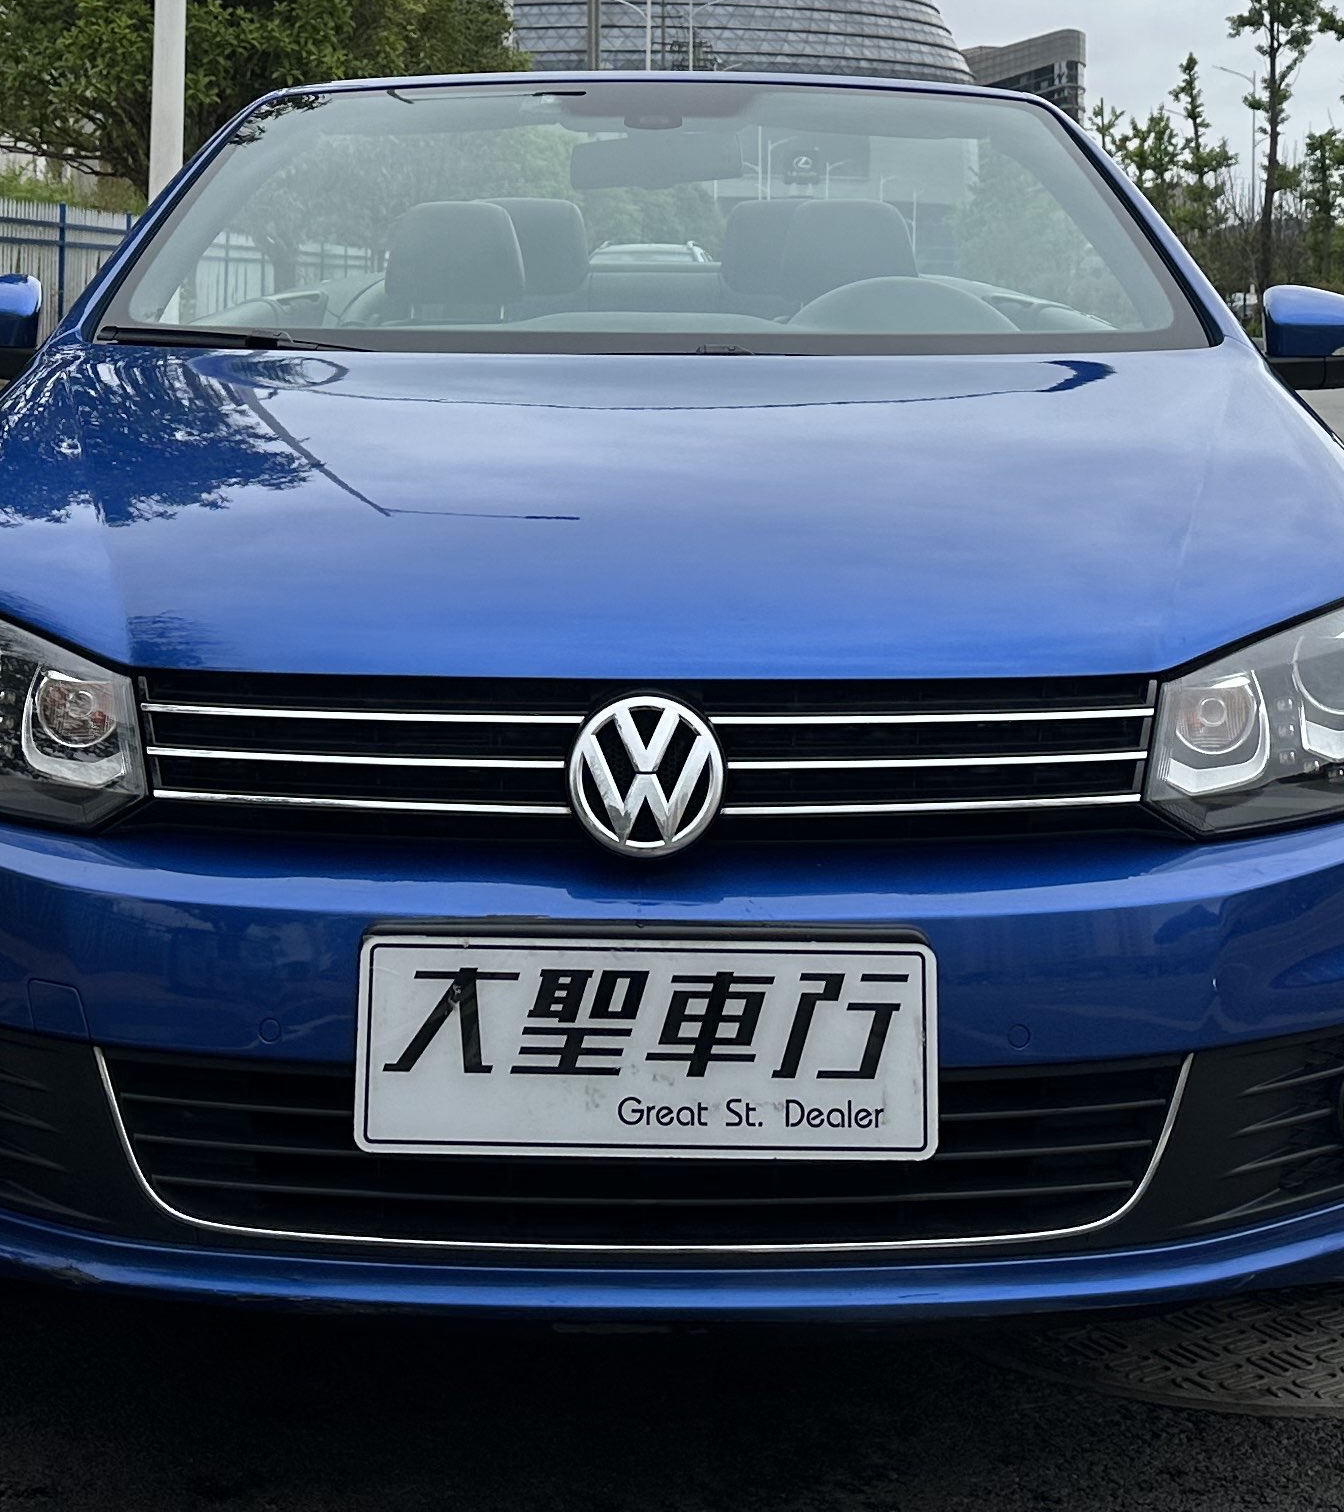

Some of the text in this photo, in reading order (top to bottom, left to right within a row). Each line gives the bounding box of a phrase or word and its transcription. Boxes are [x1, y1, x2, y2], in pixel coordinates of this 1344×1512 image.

[571, 697, 722, 855] VW
[382, 966, 910, 1080] 大聖車行
[616, 1095, 885, 1129] Great St. Dealer
